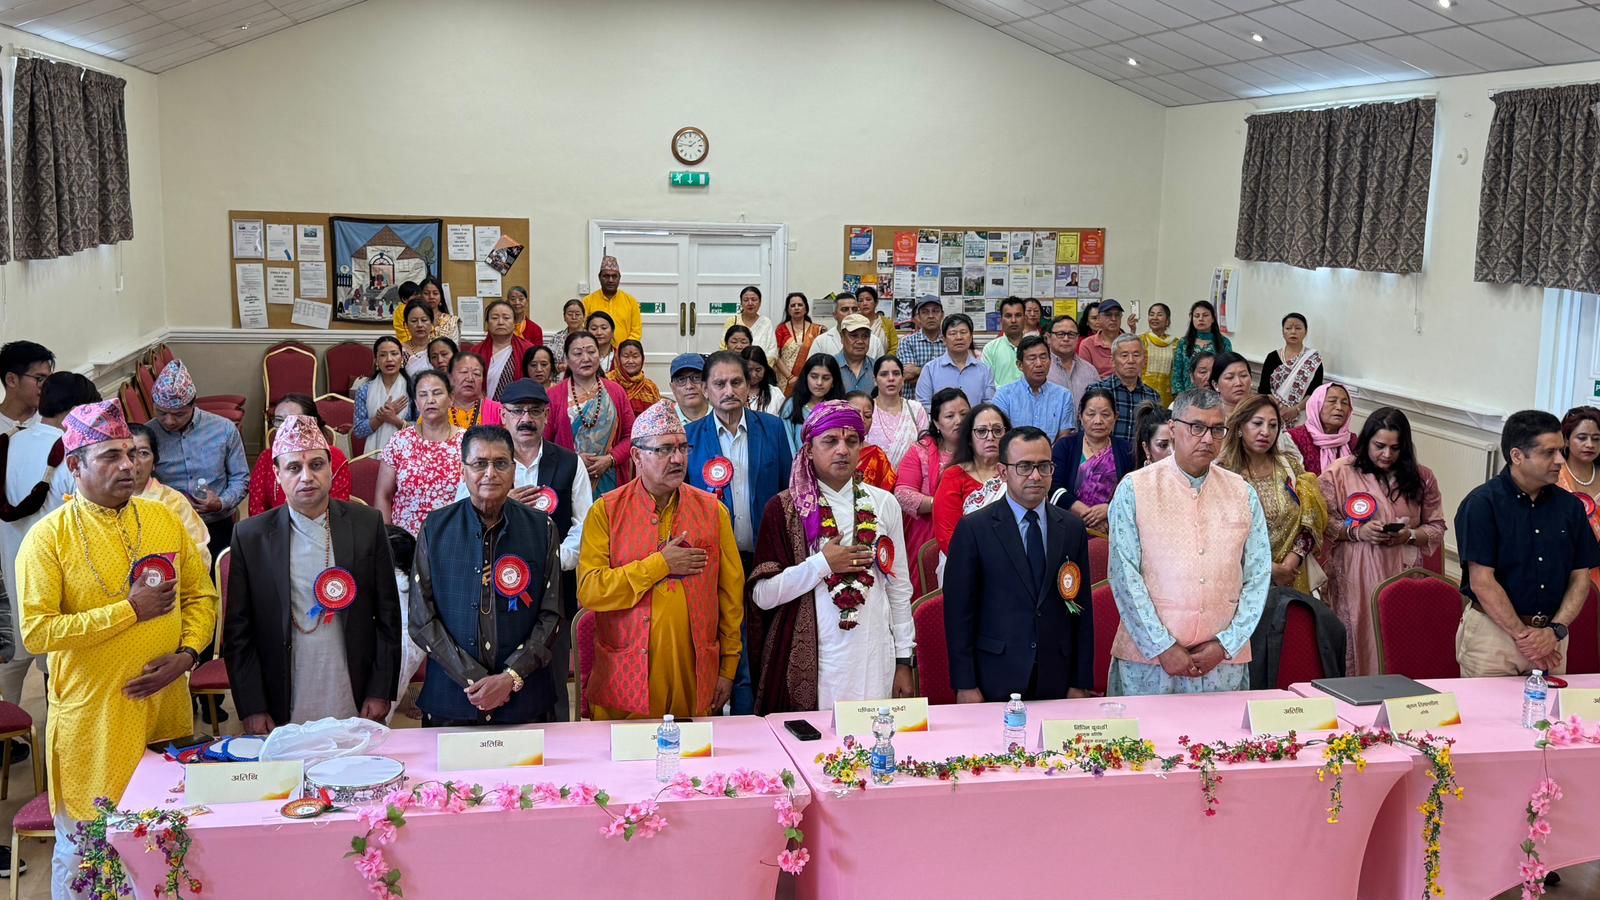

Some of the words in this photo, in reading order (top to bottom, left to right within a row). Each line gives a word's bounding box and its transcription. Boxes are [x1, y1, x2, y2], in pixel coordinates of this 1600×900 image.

[1283, 706, 1304, 715] अतिथि
[479, 739, 504, 749] अतिथि
[231, 772, 259, 782] अतिथि
